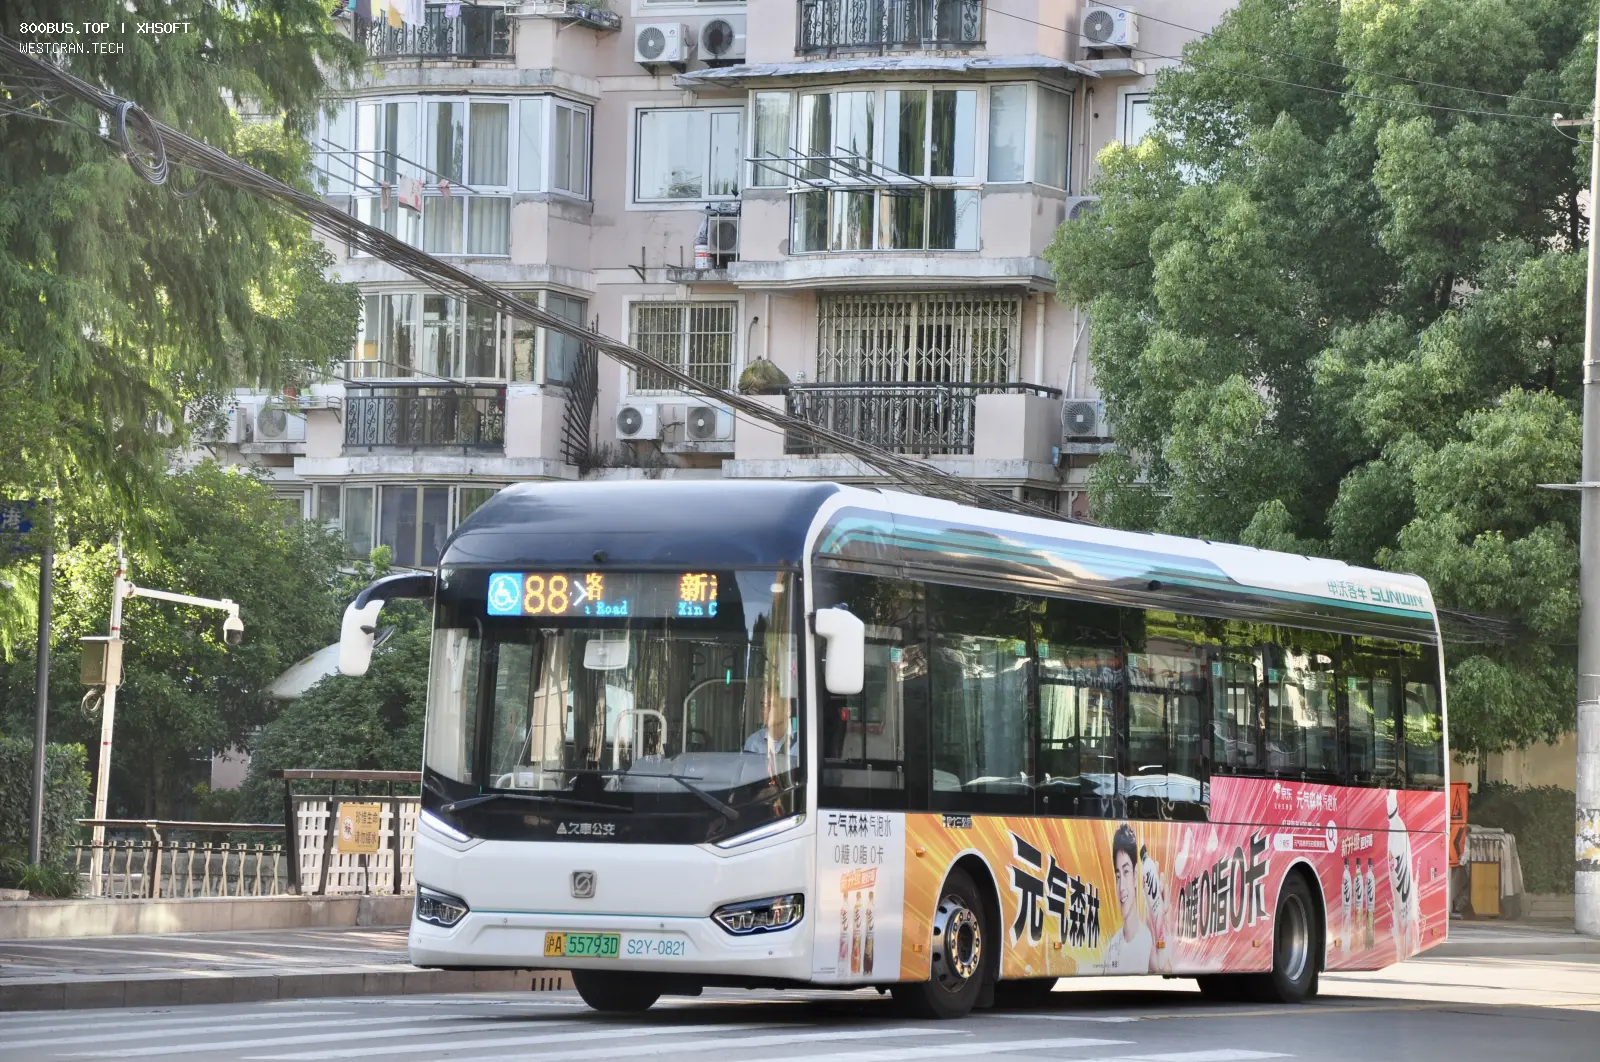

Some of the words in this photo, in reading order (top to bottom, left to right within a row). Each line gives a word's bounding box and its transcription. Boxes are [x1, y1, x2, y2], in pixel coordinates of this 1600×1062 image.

[524, 574, 569, 614] 88
[1327, 579, 1367, 601] 申沃客车
[1370, 586, 1425, 607] SUNWIN
[596, 600, 628, 616] Road
[679, 601, 703, 616] Xin
[355, 810, 378, 825] 珍惜生命
[828, 812, 892, 838] 元气森林气泡水
[834, 843, 850, 865] 0糖
[853, 844, 867, 865] 0脂
[870, 845, 884, 865] 0卡
[1006, 828, 1101, 949] 元气森林
[568, 936, 618, 954] 55793D
[626, 938, 686, 956] S2Y-0821
